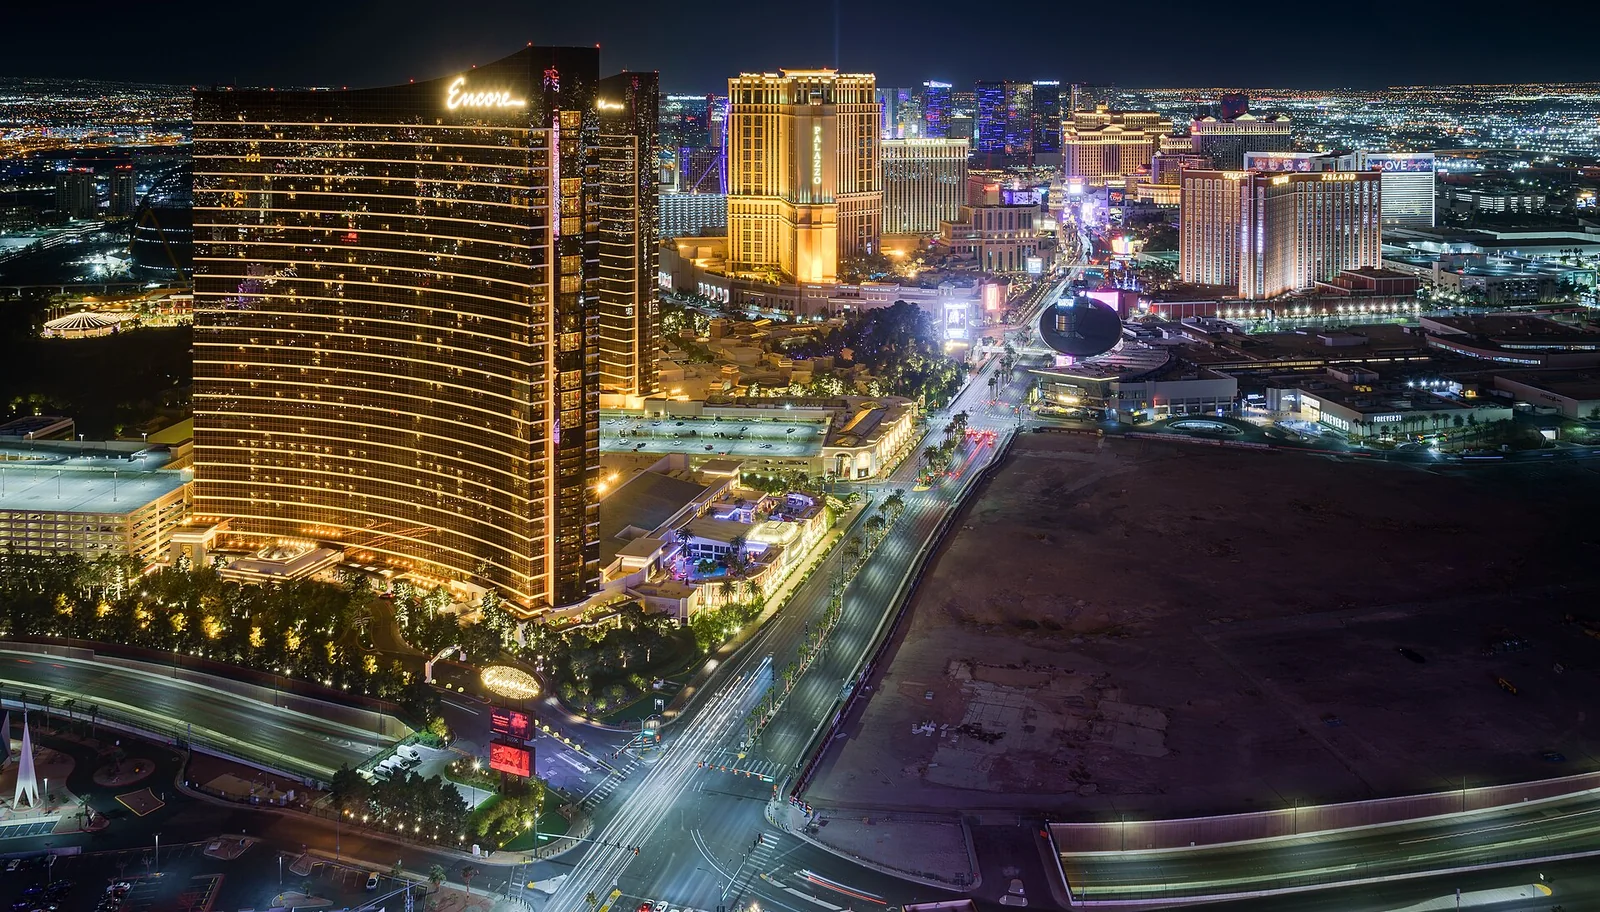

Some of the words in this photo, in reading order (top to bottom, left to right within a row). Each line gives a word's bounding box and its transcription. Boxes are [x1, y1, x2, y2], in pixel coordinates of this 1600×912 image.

[446, 76, 526, 110] Encore
[905, 138, 946, 146] VENETIAN
[813, 126, 822, 185] PALAZZO
[1379, 160, 1408, 171] LOVE
[1321, 173, 1356, 181] ISLAND
[1320, 411, 1342, 429] FOREVER
[1342, 420, 1349, 431] 21
[1373, 415, 1395, 423] FOREVER
[484, 669, 539, 695] Encore
